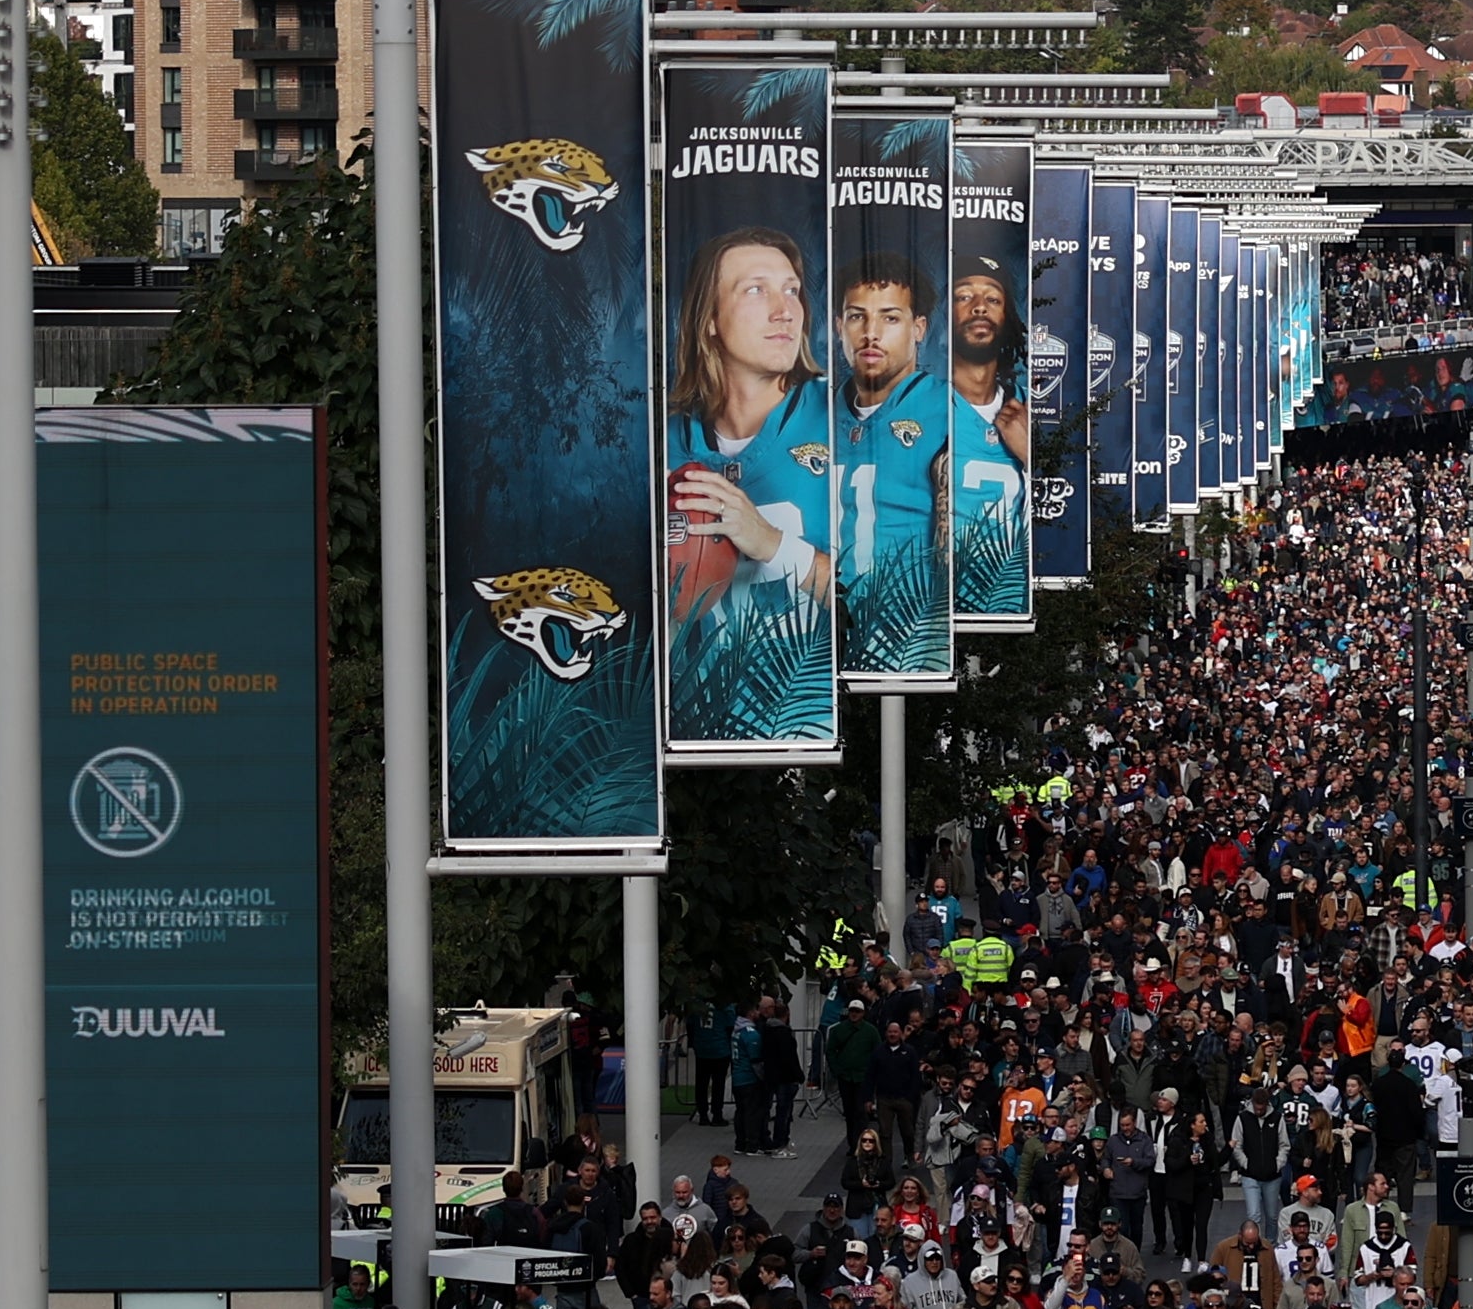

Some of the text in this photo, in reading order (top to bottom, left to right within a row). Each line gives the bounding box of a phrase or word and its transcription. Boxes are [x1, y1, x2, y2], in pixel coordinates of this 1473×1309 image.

[689, 127, 803, 141] JACKSONVILLE
[672, 144, 820, 179] JAGUARS
[1314, 140, 1447, 174] PARK
[835, 165, 929, 178] JACKSONVILLE
[953, 186, 1013, 197] KSONVILLE
[952, 198, 1025, 223] GUARS
[1031, 239, 1079, 254] etApp
[71, 653, 218, 671] PUBLIC SPACE
[71, 674, 278, 693] PROTECTION ORDER
[71, 696, 218, 714] IN OPERATION
[70, 888, 276, 907] DRINKING ALCOHOL
[71, 911, 91, 928] IS
[96, 910, 137, 928] NOT
[146, 910, 262, 928] PERMITTED
[71, 931, 184, 949] ON-STREET
[72, 1006, 225, 1038] DUUUVAL
[434, 1056, 464, 1073] SOLD
[469, 1056, 499, 1073] HERE
[919, 1290, 954, 1309] TEXANS
